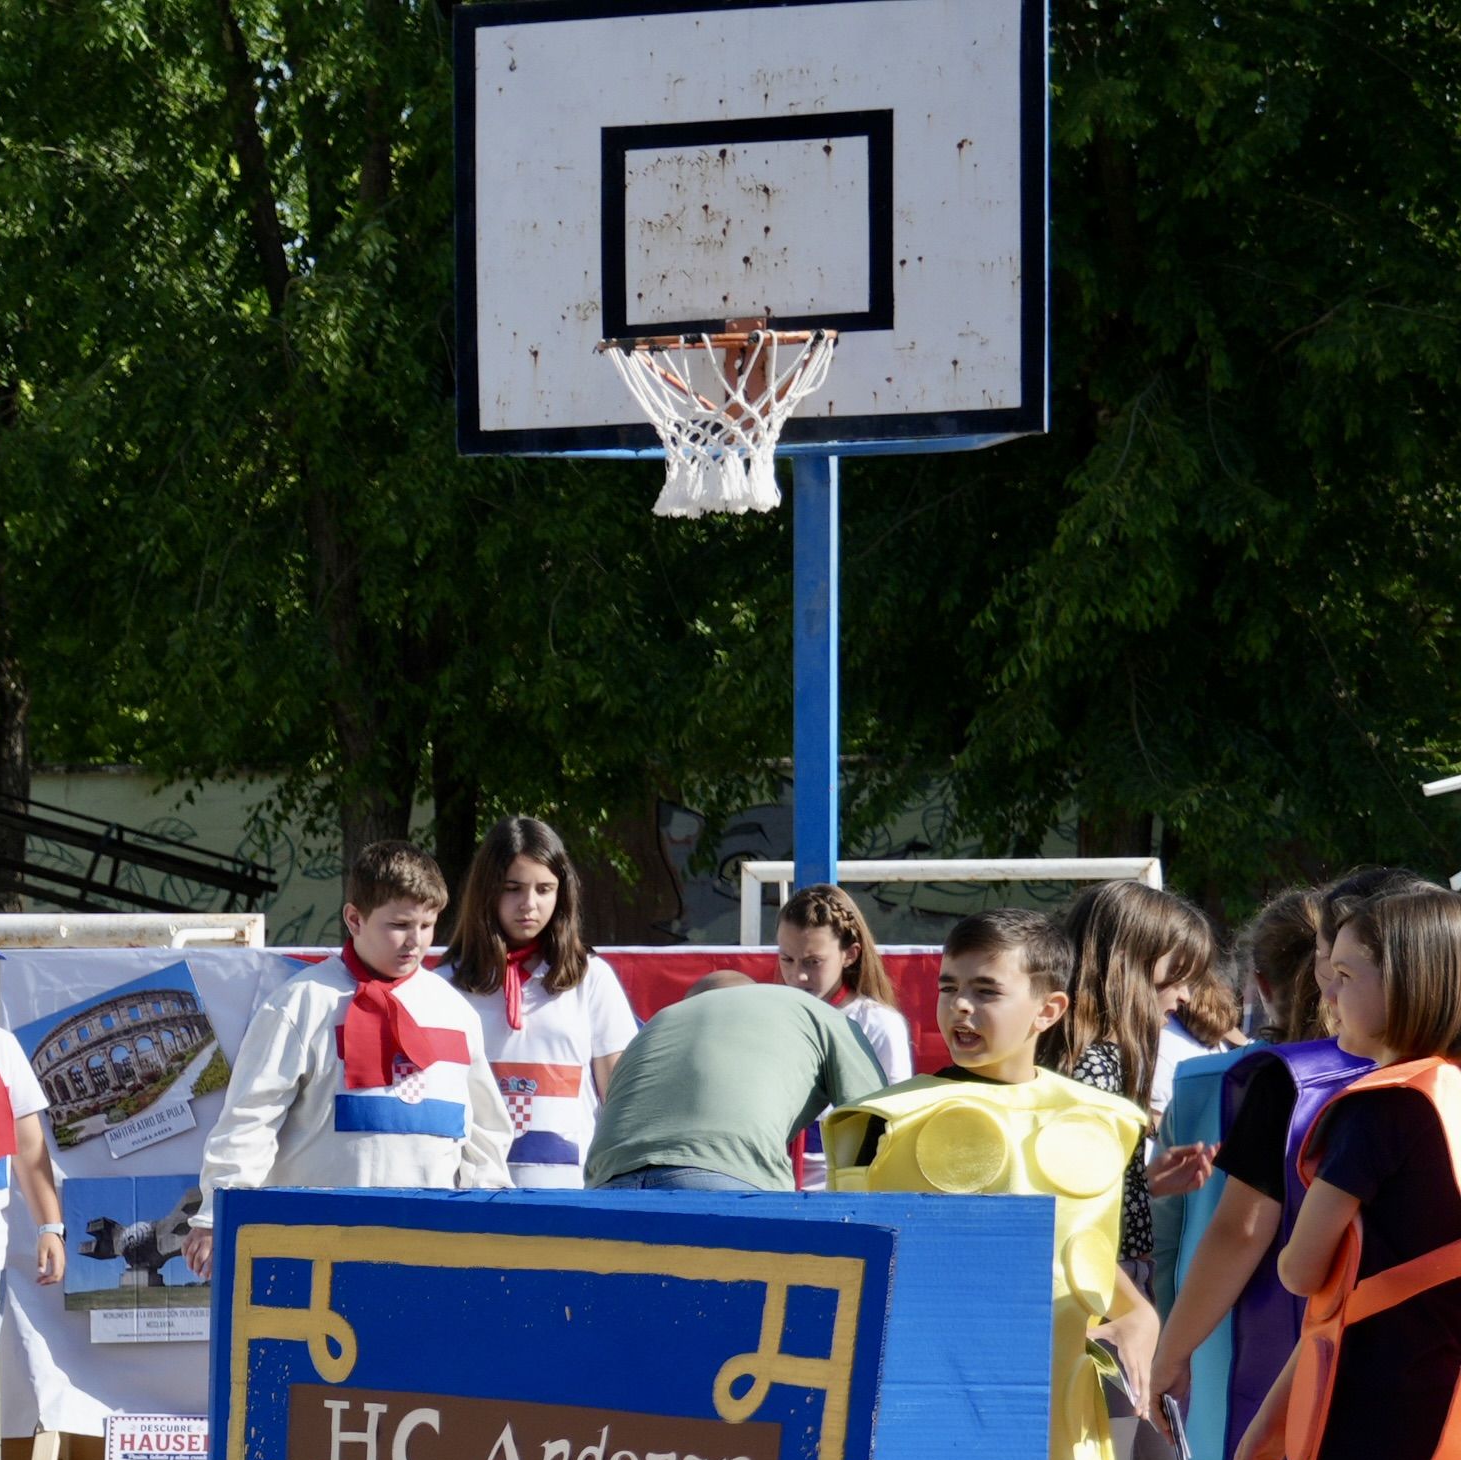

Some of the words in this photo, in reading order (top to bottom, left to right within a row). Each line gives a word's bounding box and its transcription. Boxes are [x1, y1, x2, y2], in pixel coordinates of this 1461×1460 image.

[155, 1111, 167, 1125] DE
[166, 1104, 187, 1120] PULA
[140, 1424, 193, 1433] DESCUBRE
